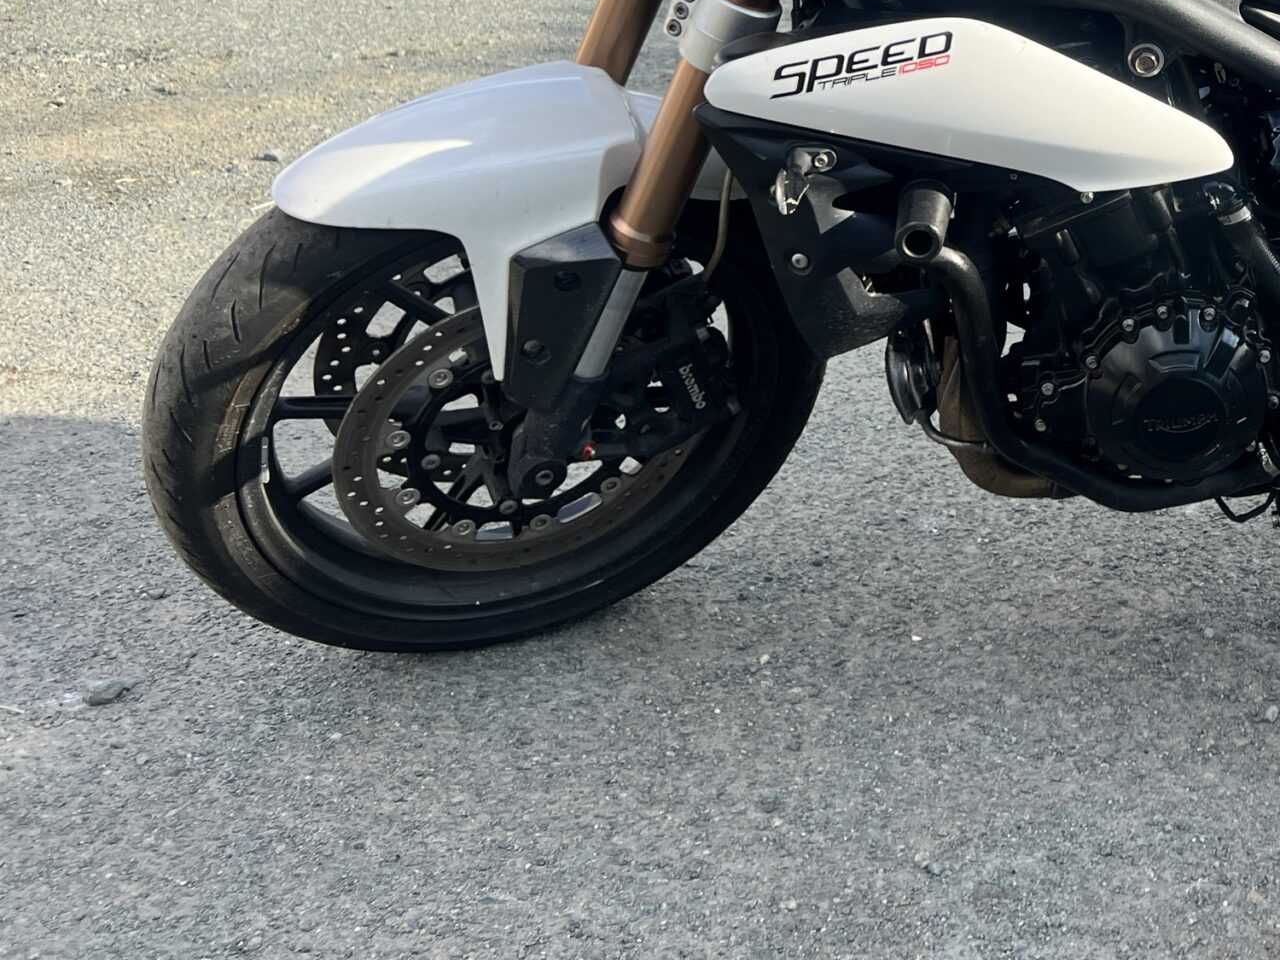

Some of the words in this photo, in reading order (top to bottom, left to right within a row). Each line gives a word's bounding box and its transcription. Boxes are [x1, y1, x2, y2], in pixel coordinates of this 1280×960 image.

[769, 31, 953, 100] SPEED
[818, 66, 898, 90] TRIPLE
[898, 54, 951, 75] 1050
[678, 362, 706, 410] brembo
[1143, 411, 1219, 433] TRIUMPH
